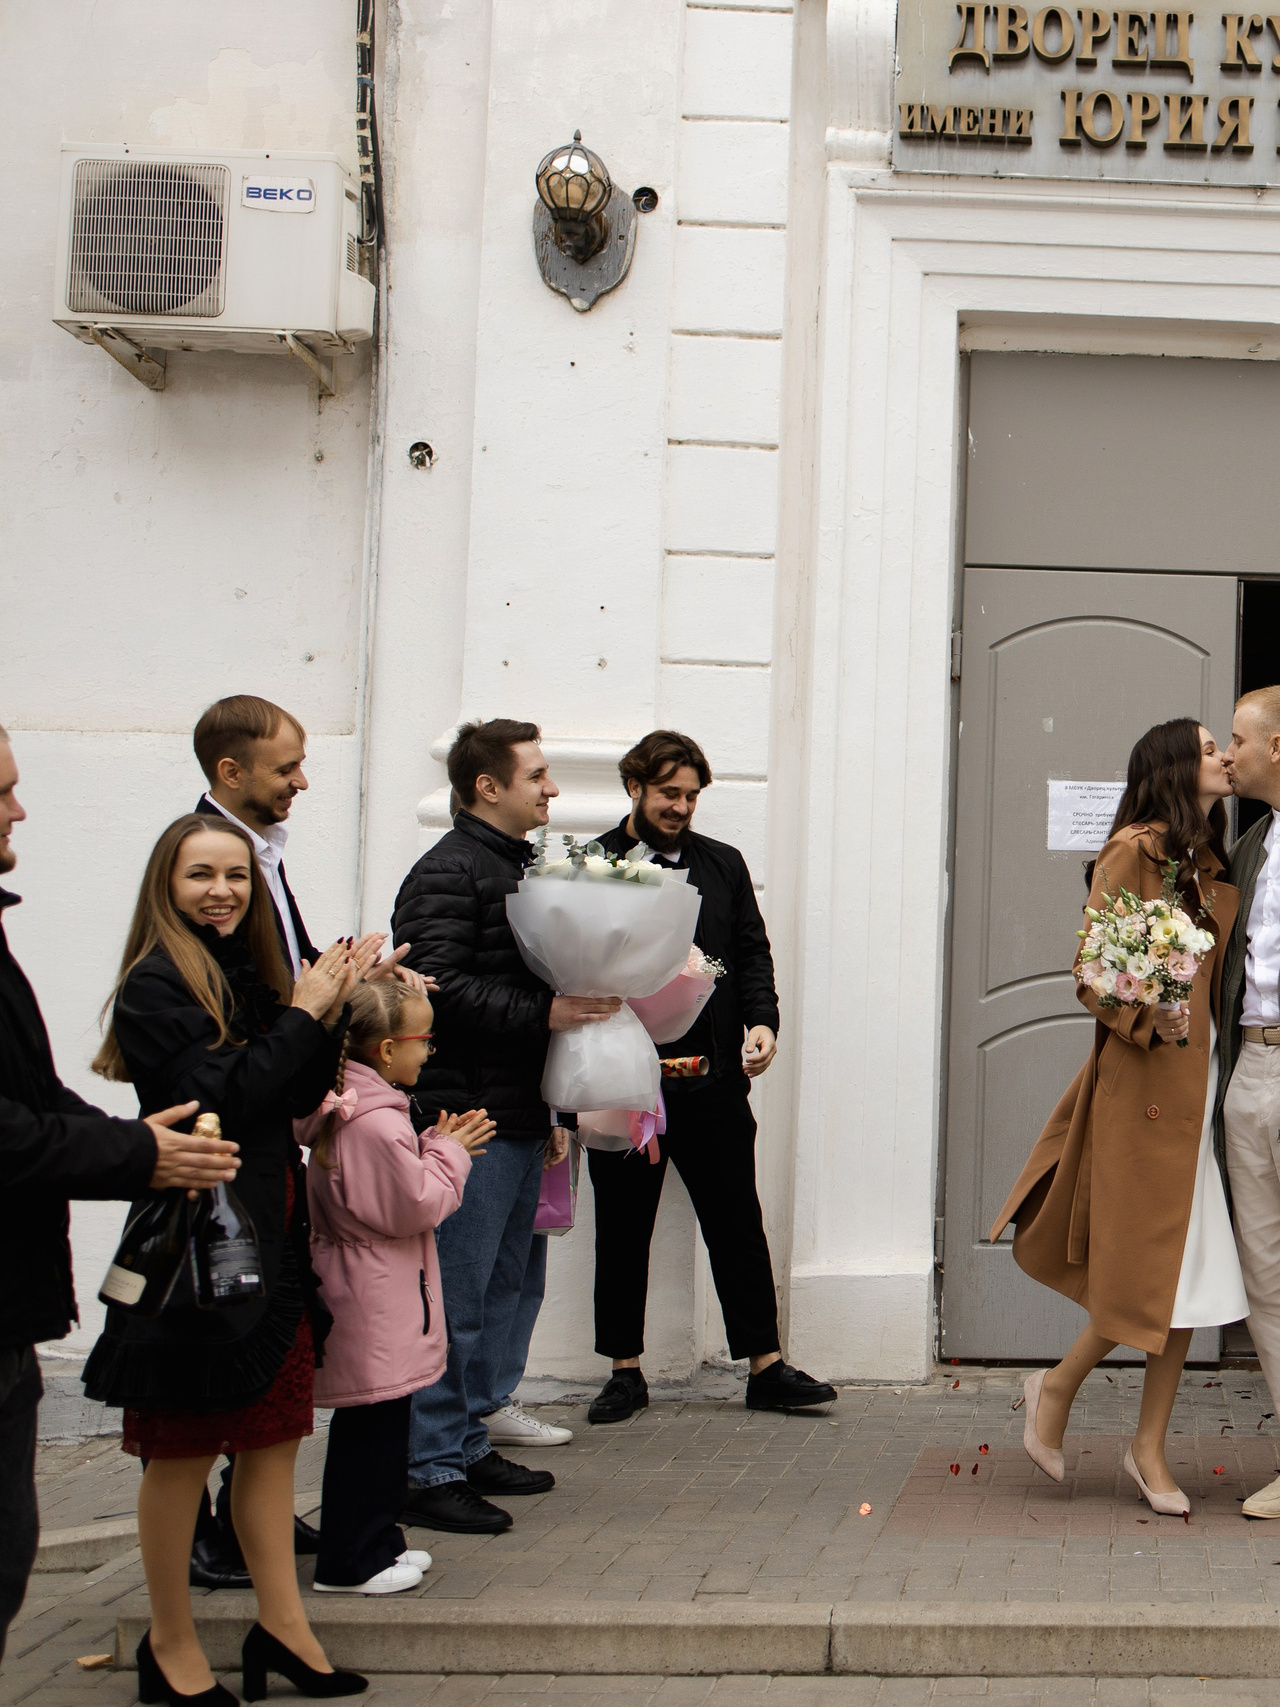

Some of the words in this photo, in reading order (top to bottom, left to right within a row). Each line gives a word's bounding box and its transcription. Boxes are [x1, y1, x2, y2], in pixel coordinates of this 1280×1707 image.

[948, 2, 1194, 82] ДВОРЕЦ
[899, 102, 1034, 144] ИМЕНИ
[1059, 88, 1254, 153] ЮРИЯ
[246, 186, 313, 201] BEKO
